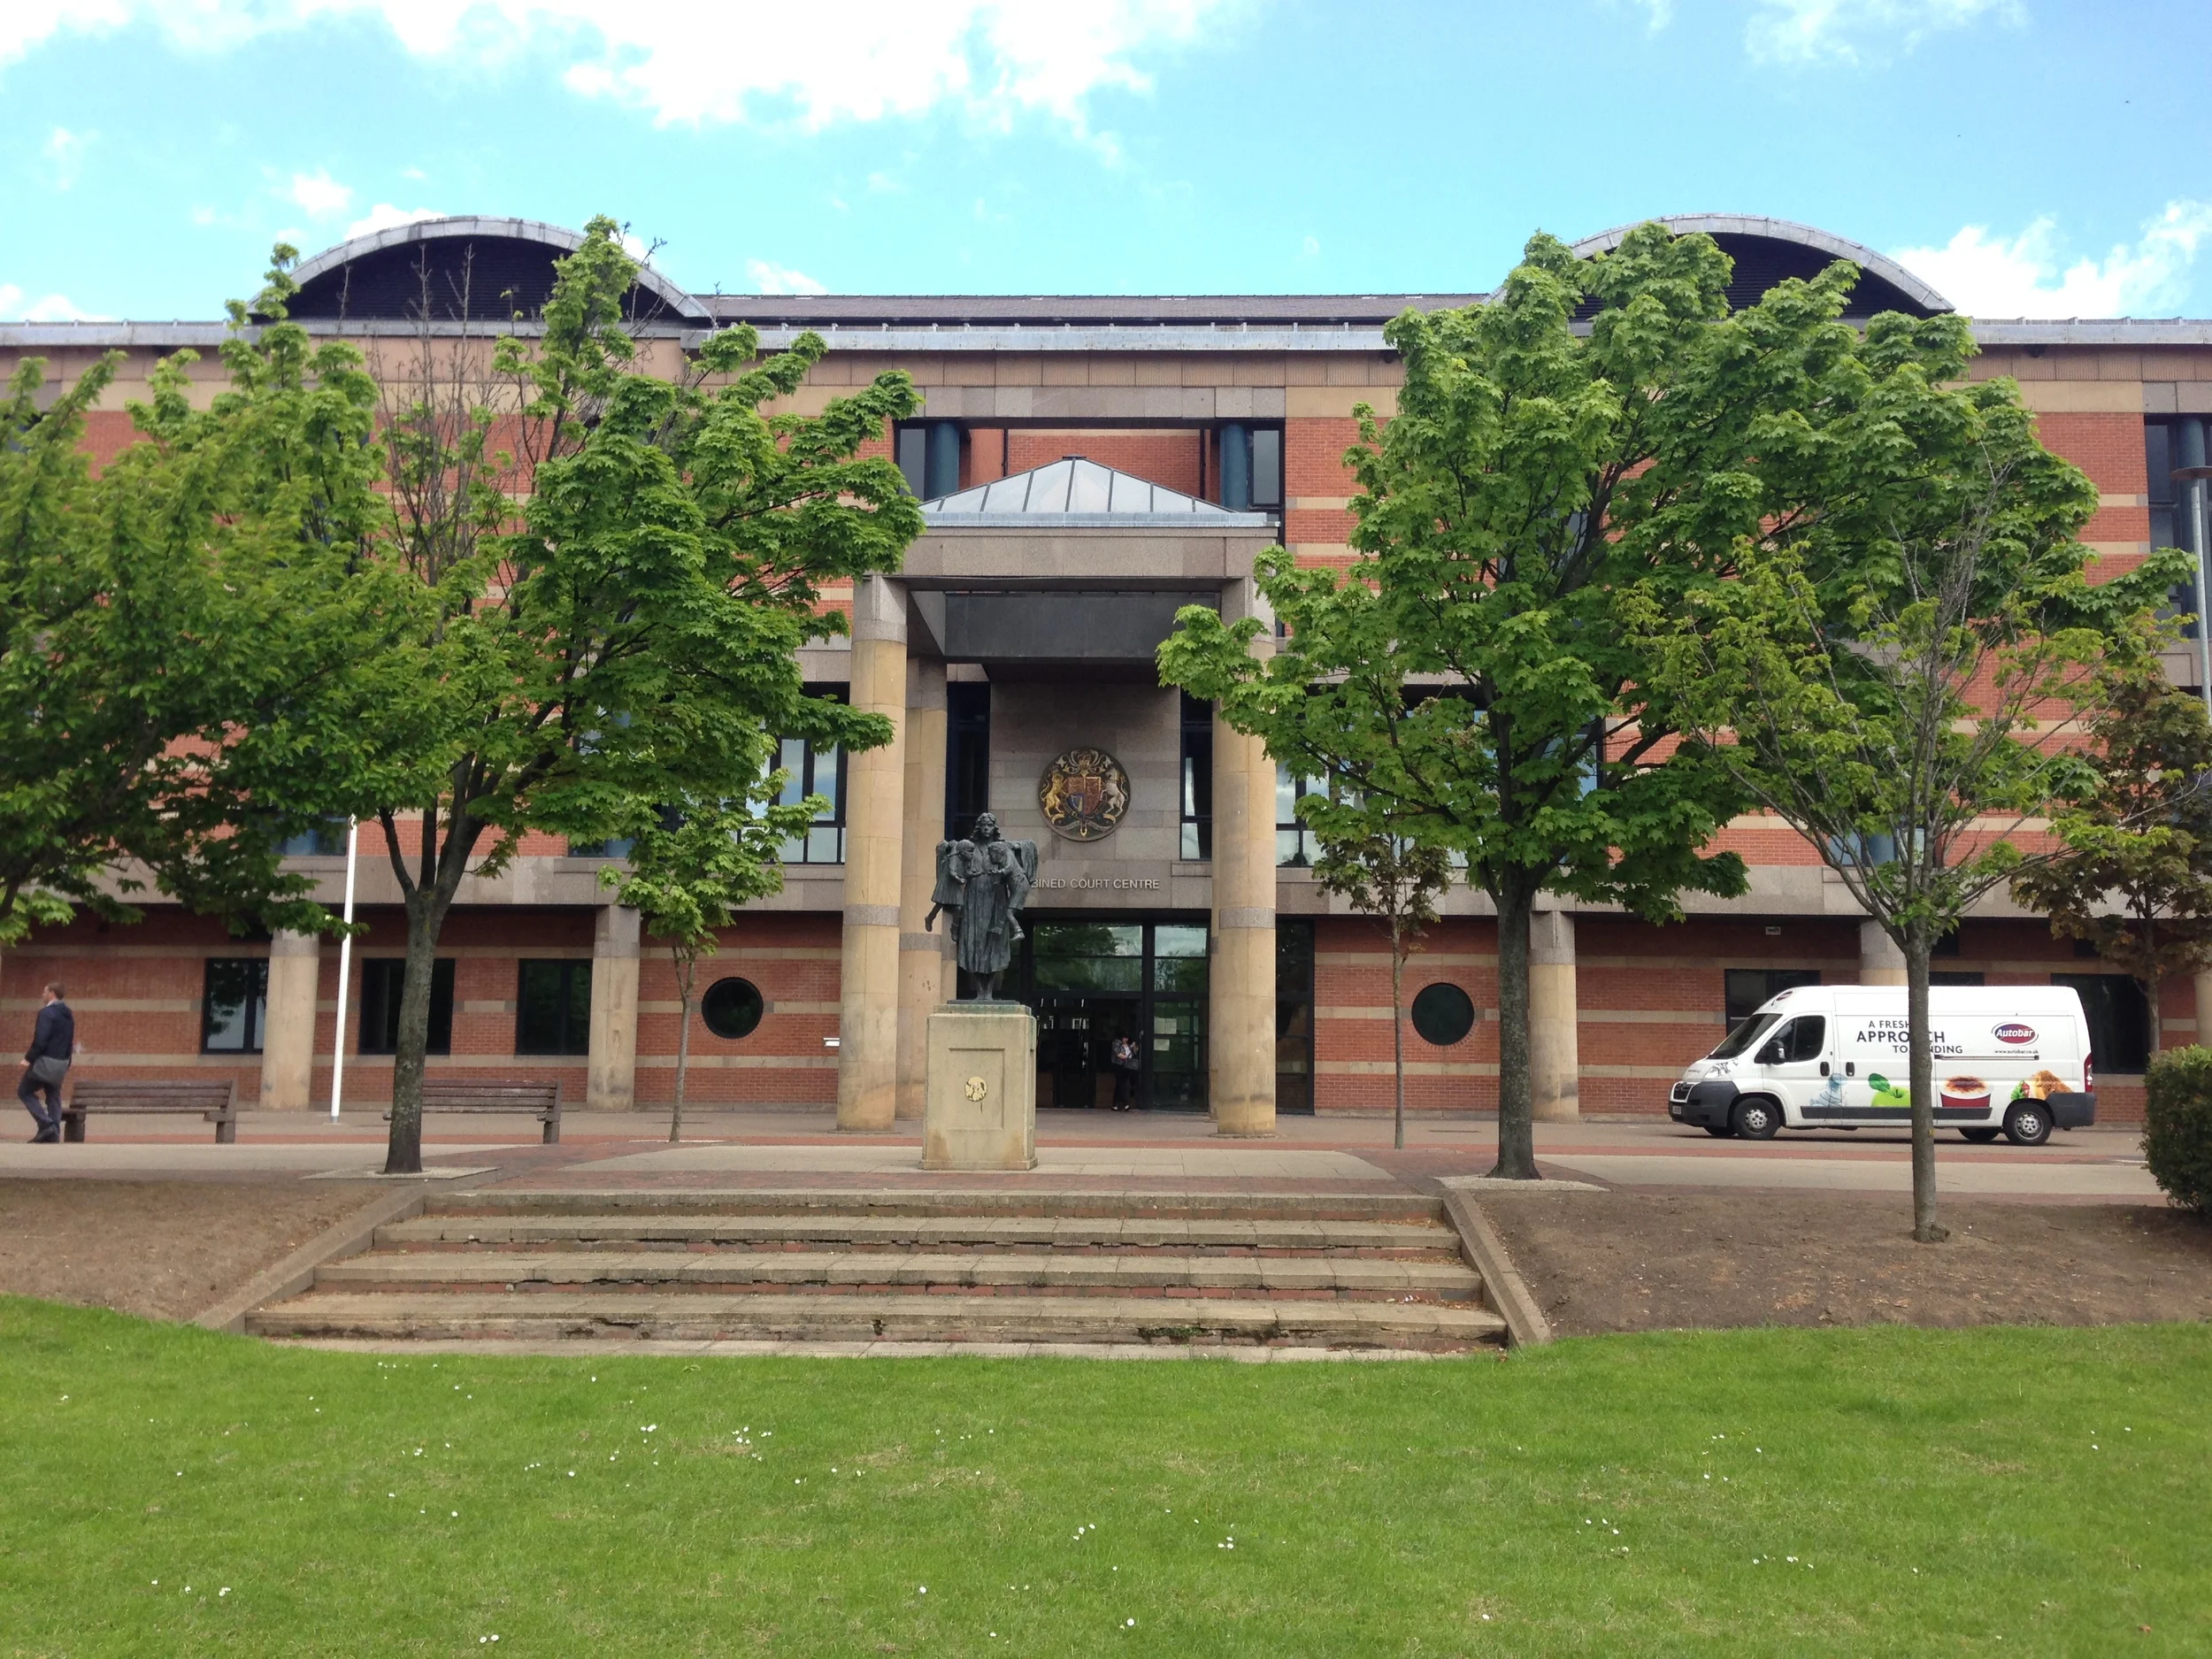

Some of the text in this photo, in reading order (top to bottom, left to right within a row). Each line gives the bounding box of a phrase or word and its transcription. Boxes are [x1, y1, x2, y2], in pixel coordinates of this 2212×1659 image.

[1070, 879, 1110, 889] COURT
[1113, 879, 1160, 889] CENTRE
[1868, 1020, 1910, 1029] A FRESH
[1856, 1031, 1946, 1043] APPROH
[1996, 1028, 2034, 1038] Autobar
[1893, 1045, 1909, 1054] TO
